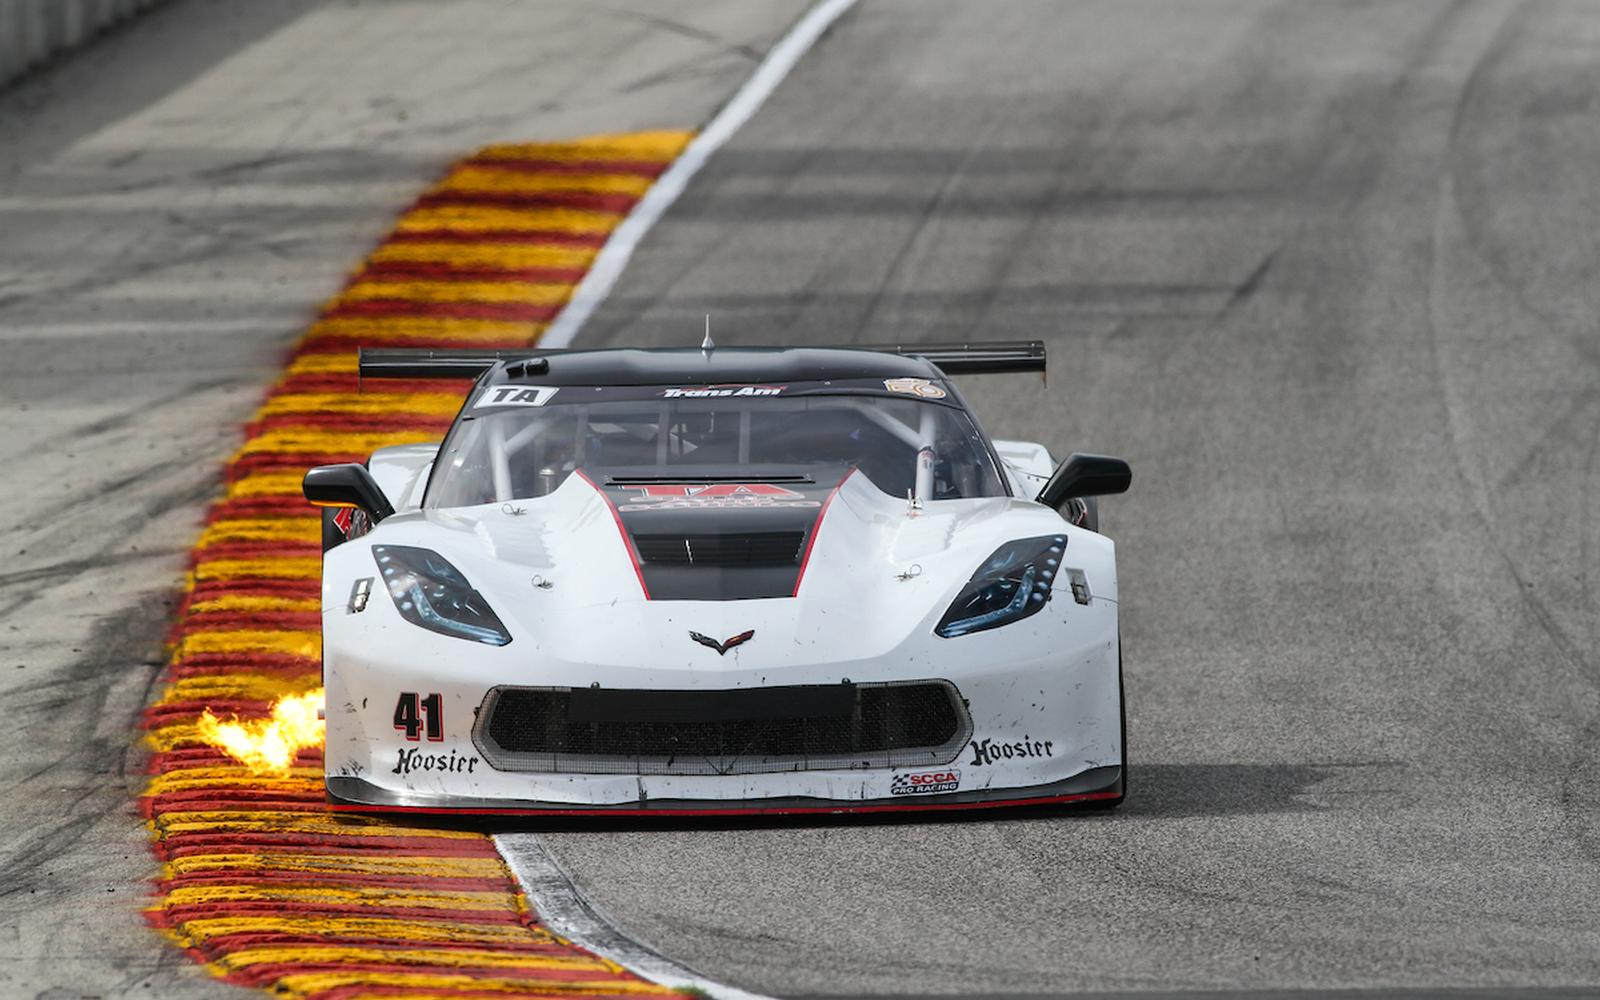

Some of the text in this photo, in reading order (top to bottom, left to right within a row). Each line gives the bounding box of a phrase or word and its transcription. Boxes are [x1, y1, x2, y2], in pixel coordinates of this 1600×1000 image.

[493, 388, 540, 403] TA
[664, 387, 781, 398] Trans Am
[393, 691, 444, 742] 41
[969, 734, 1054, 766] Hoosier
[392, 747, 479, 774] Hoosier
[910, 772, 958, 785] SCCA
[893, 782, 958, 795] PRO RACING
